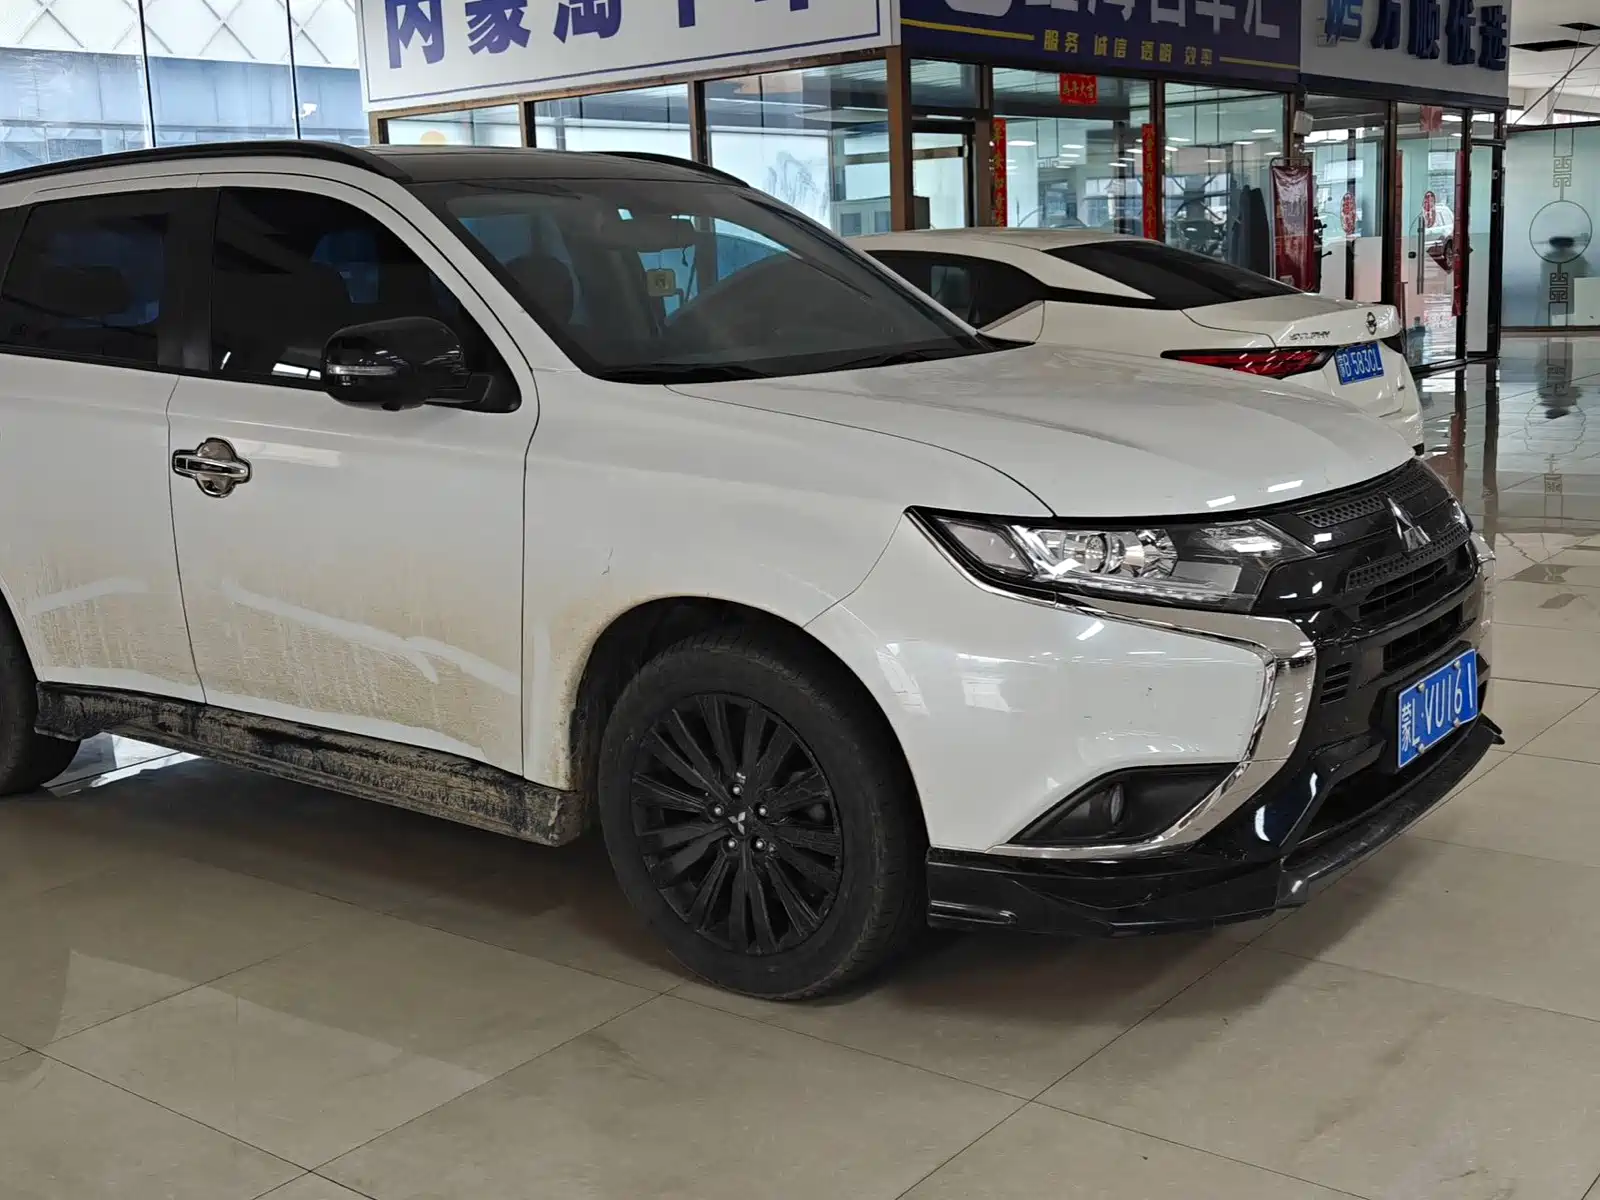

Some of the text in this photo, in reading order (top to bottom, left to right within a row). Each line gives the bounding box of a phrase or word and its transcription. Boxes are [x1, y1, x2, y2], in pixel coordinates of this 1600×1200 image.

[1043, 29, 1080, 54] 服务
[1093, 33, 1128, 60] 诚信
[1140, 40, 1173, 64] 透明
